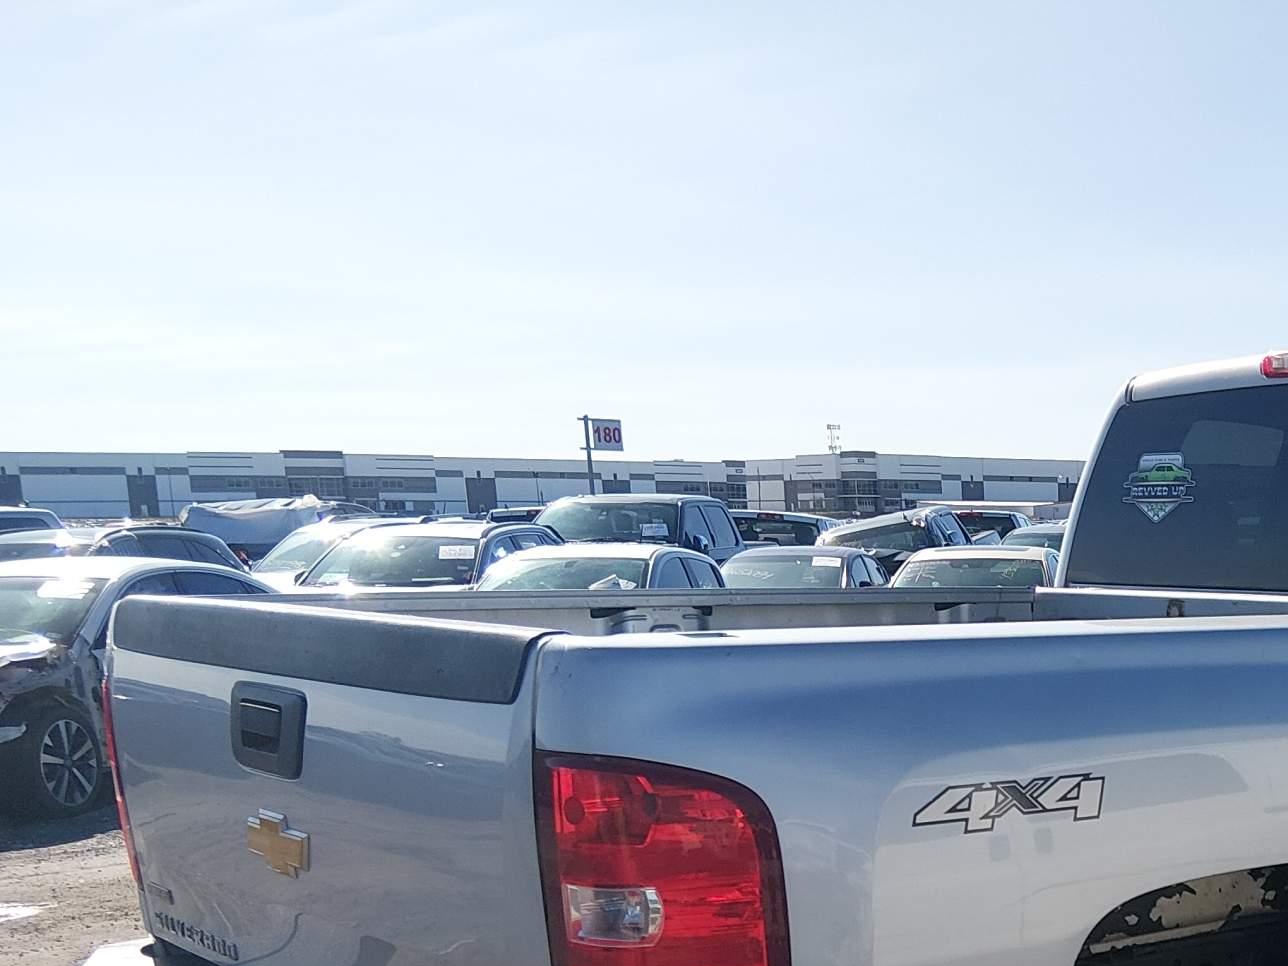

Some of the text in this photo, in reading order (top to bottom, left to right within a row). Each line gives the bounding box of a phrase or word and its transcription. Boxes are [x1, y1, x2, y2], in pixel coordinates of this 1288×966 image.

[594, 426, 622, 443] 180
[1131, 486, 1186, 496] REVVED UP
